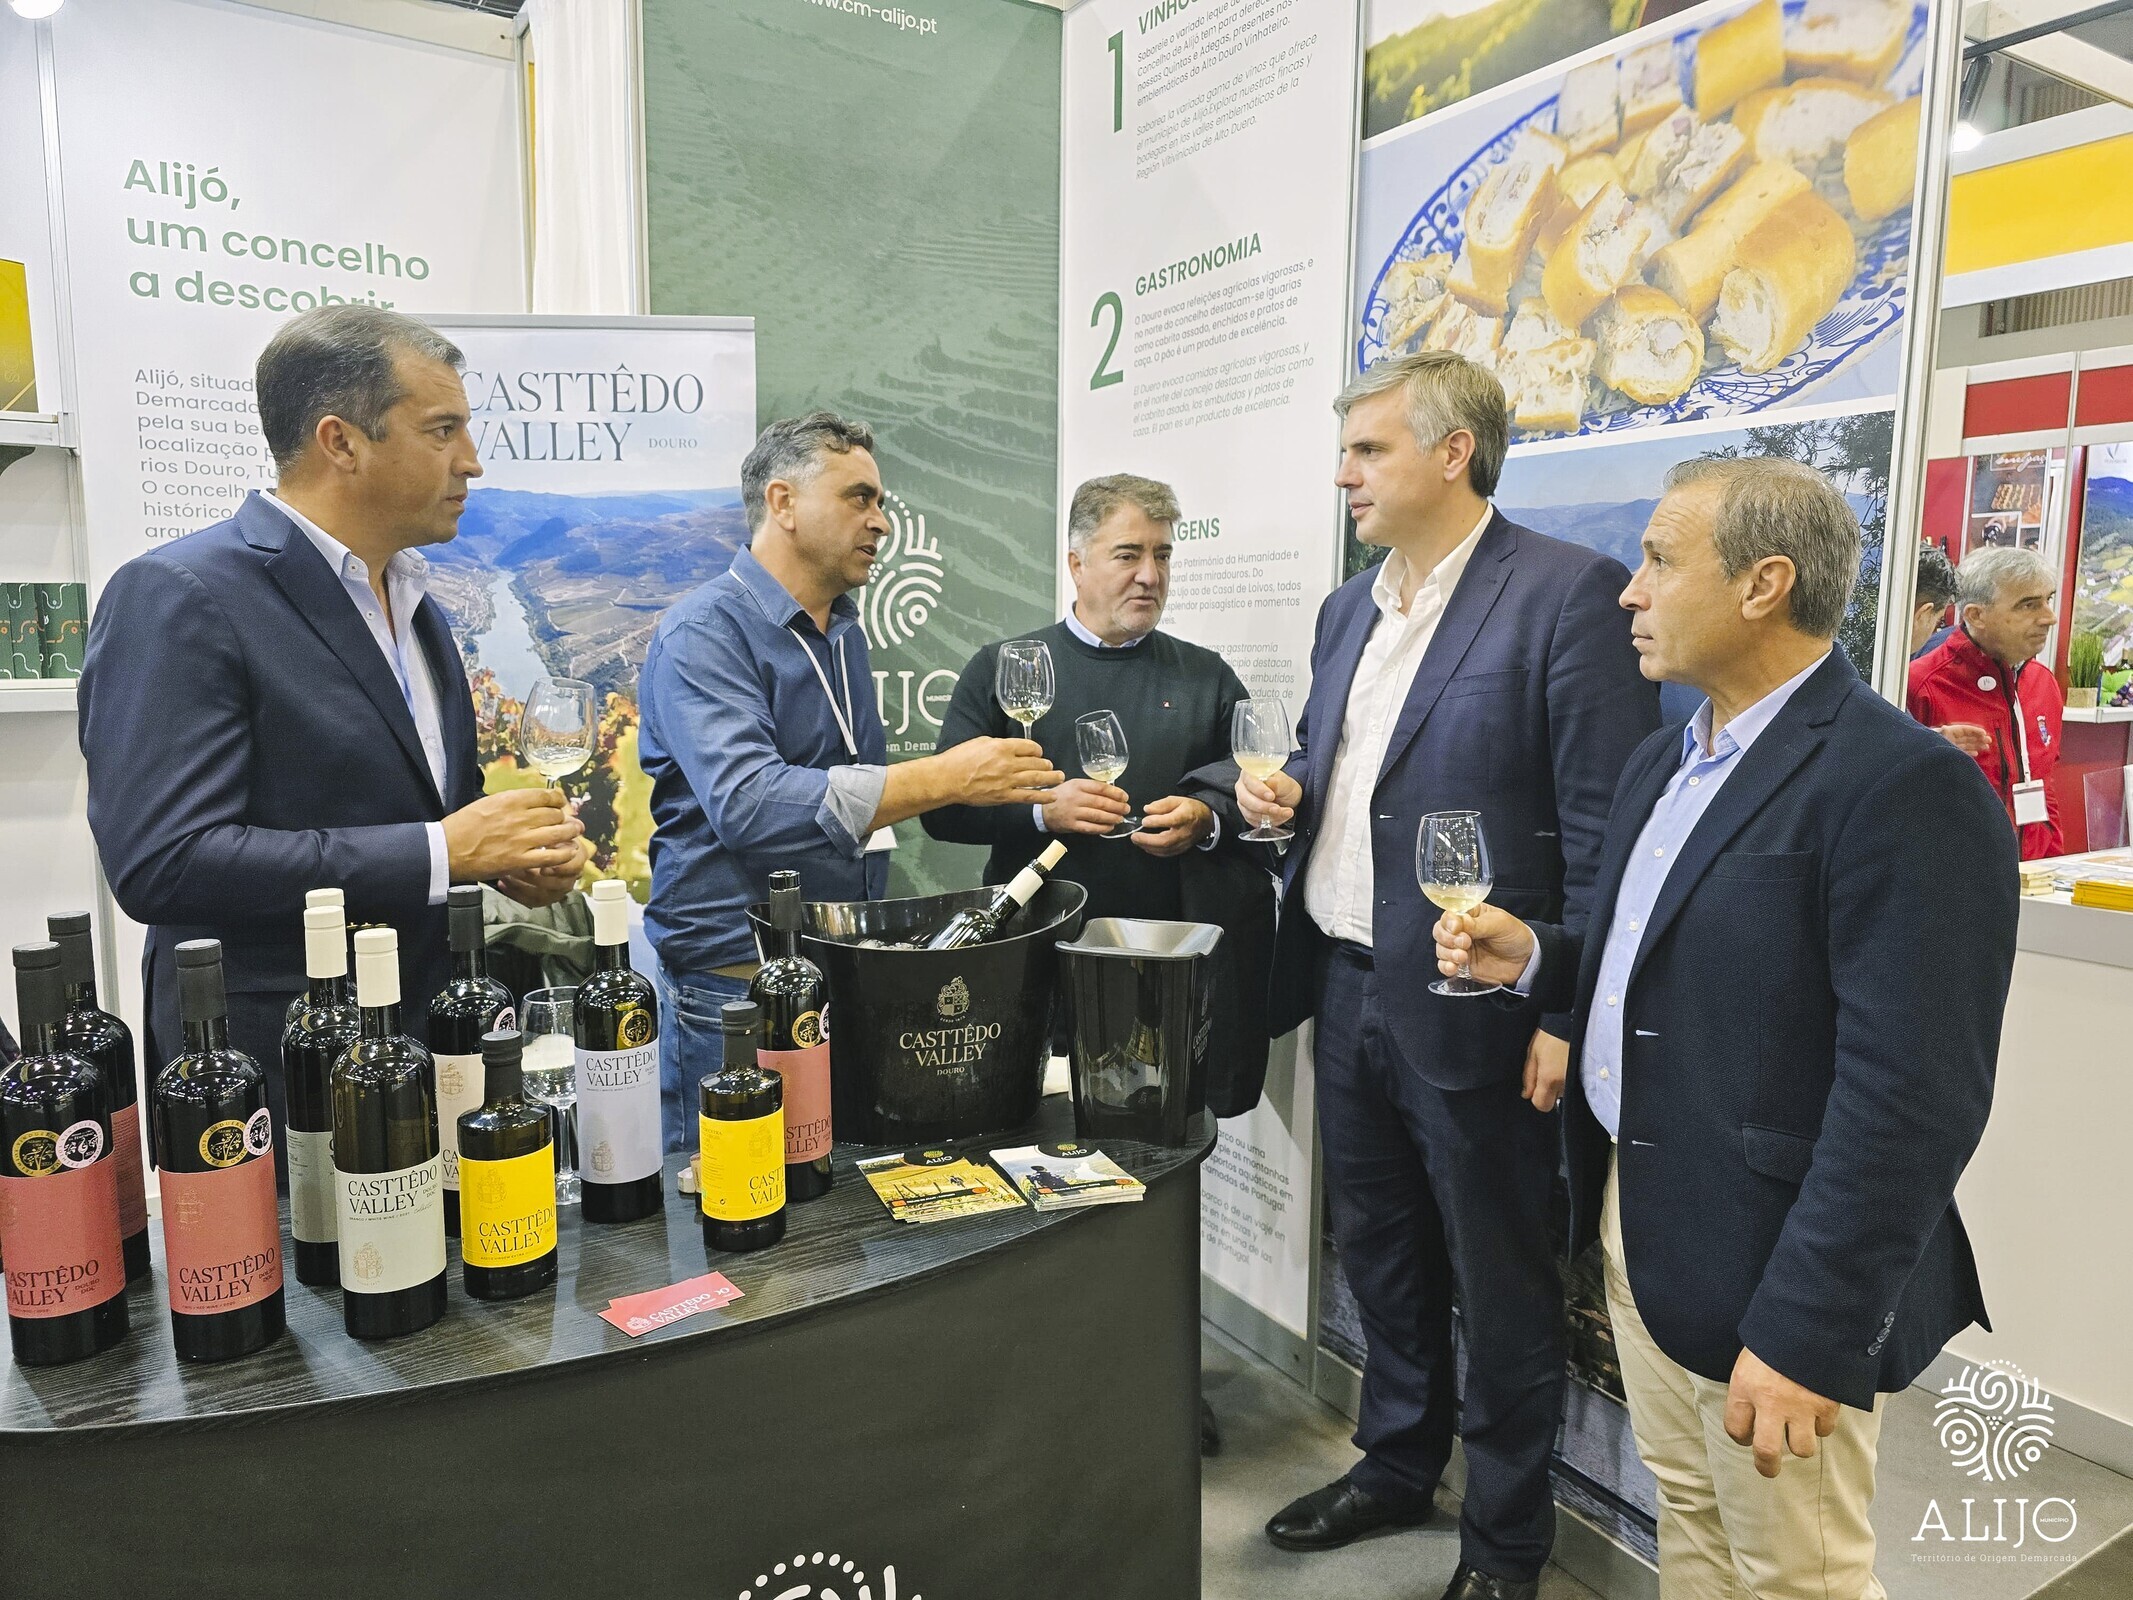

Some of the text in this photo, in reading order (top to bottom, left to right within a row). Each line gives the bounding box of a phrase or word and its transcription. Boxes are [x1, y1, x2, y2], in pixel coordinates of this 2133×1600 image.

[1169, 34, 1174, 43] o
[1175, 16, 1204, 39] variado
[1206, 1, 1228, 21] leque
[1137, 12, 1237, 76] Concelho de Alijó tem para
[1137, 0, 1292, 91] nossas Quintas e Adegas, presentes nos
[1136, 16, 1290, 106] emblemáticos do Alto Douro Vinhateiro.
[1107, 30, 1123, 133] 1
[124, 159, 240, 210] Alijó,
[127, 217, 429, 280] um concelho
[1135, 233, 1262, 296] GASTRONOMIA
[129, 270, 160, 298] a
[1134, 258, 1313, 325] O Douro evoca refeições agrícolas vigorosas, e
[1134, 278, 1301, 339] no norte do concelho destacam-se iguarias
[1133, 295, 1297, 354] como cabrito assado, enchidos e pratos de
[1090, 291, 1124, 391] 2
[135, 369, 254, 392] Alijó, situad
[461, 363, 704, 414] CASTTÊDO
[138, 415, 183, 432] pela
[191, 420, 227, 433] sua
[139, 435, 257, 459] localização
[648, 437, 698, 449] DOURO
[141, 457, 178, 473] rios
[185, 460, 250, 479] Douro,
[142, 480, 247, 498] O concelh
[144, 501, 233, 519] histórico
[1183, 549, 1299, 568] Património da Humanidade e
[1188, 566, 1263, 582] dos miradouros. Do
[900, 1022, 1002, 1050] CASTTÊDO
[586, 1048, 656, 1072] CASTTÊDO
[915, 1042, 987, 1067] VALLEY
[587, 1068, 641, 1086] VALLEY
[937, 1066, 965, 1076] DOURO
[348, 1164, 437, 1196] CASTTÊDO
[349, 1190, 418, 1214] VALLEY
[480, 1228, 543, 1254] VALLEY
[179, 1247, 275, 1284] CASTTÊDO
[10, 1286, 68, 1306] ALLEY
[181, 1276, 253, 1302] VALLEY
